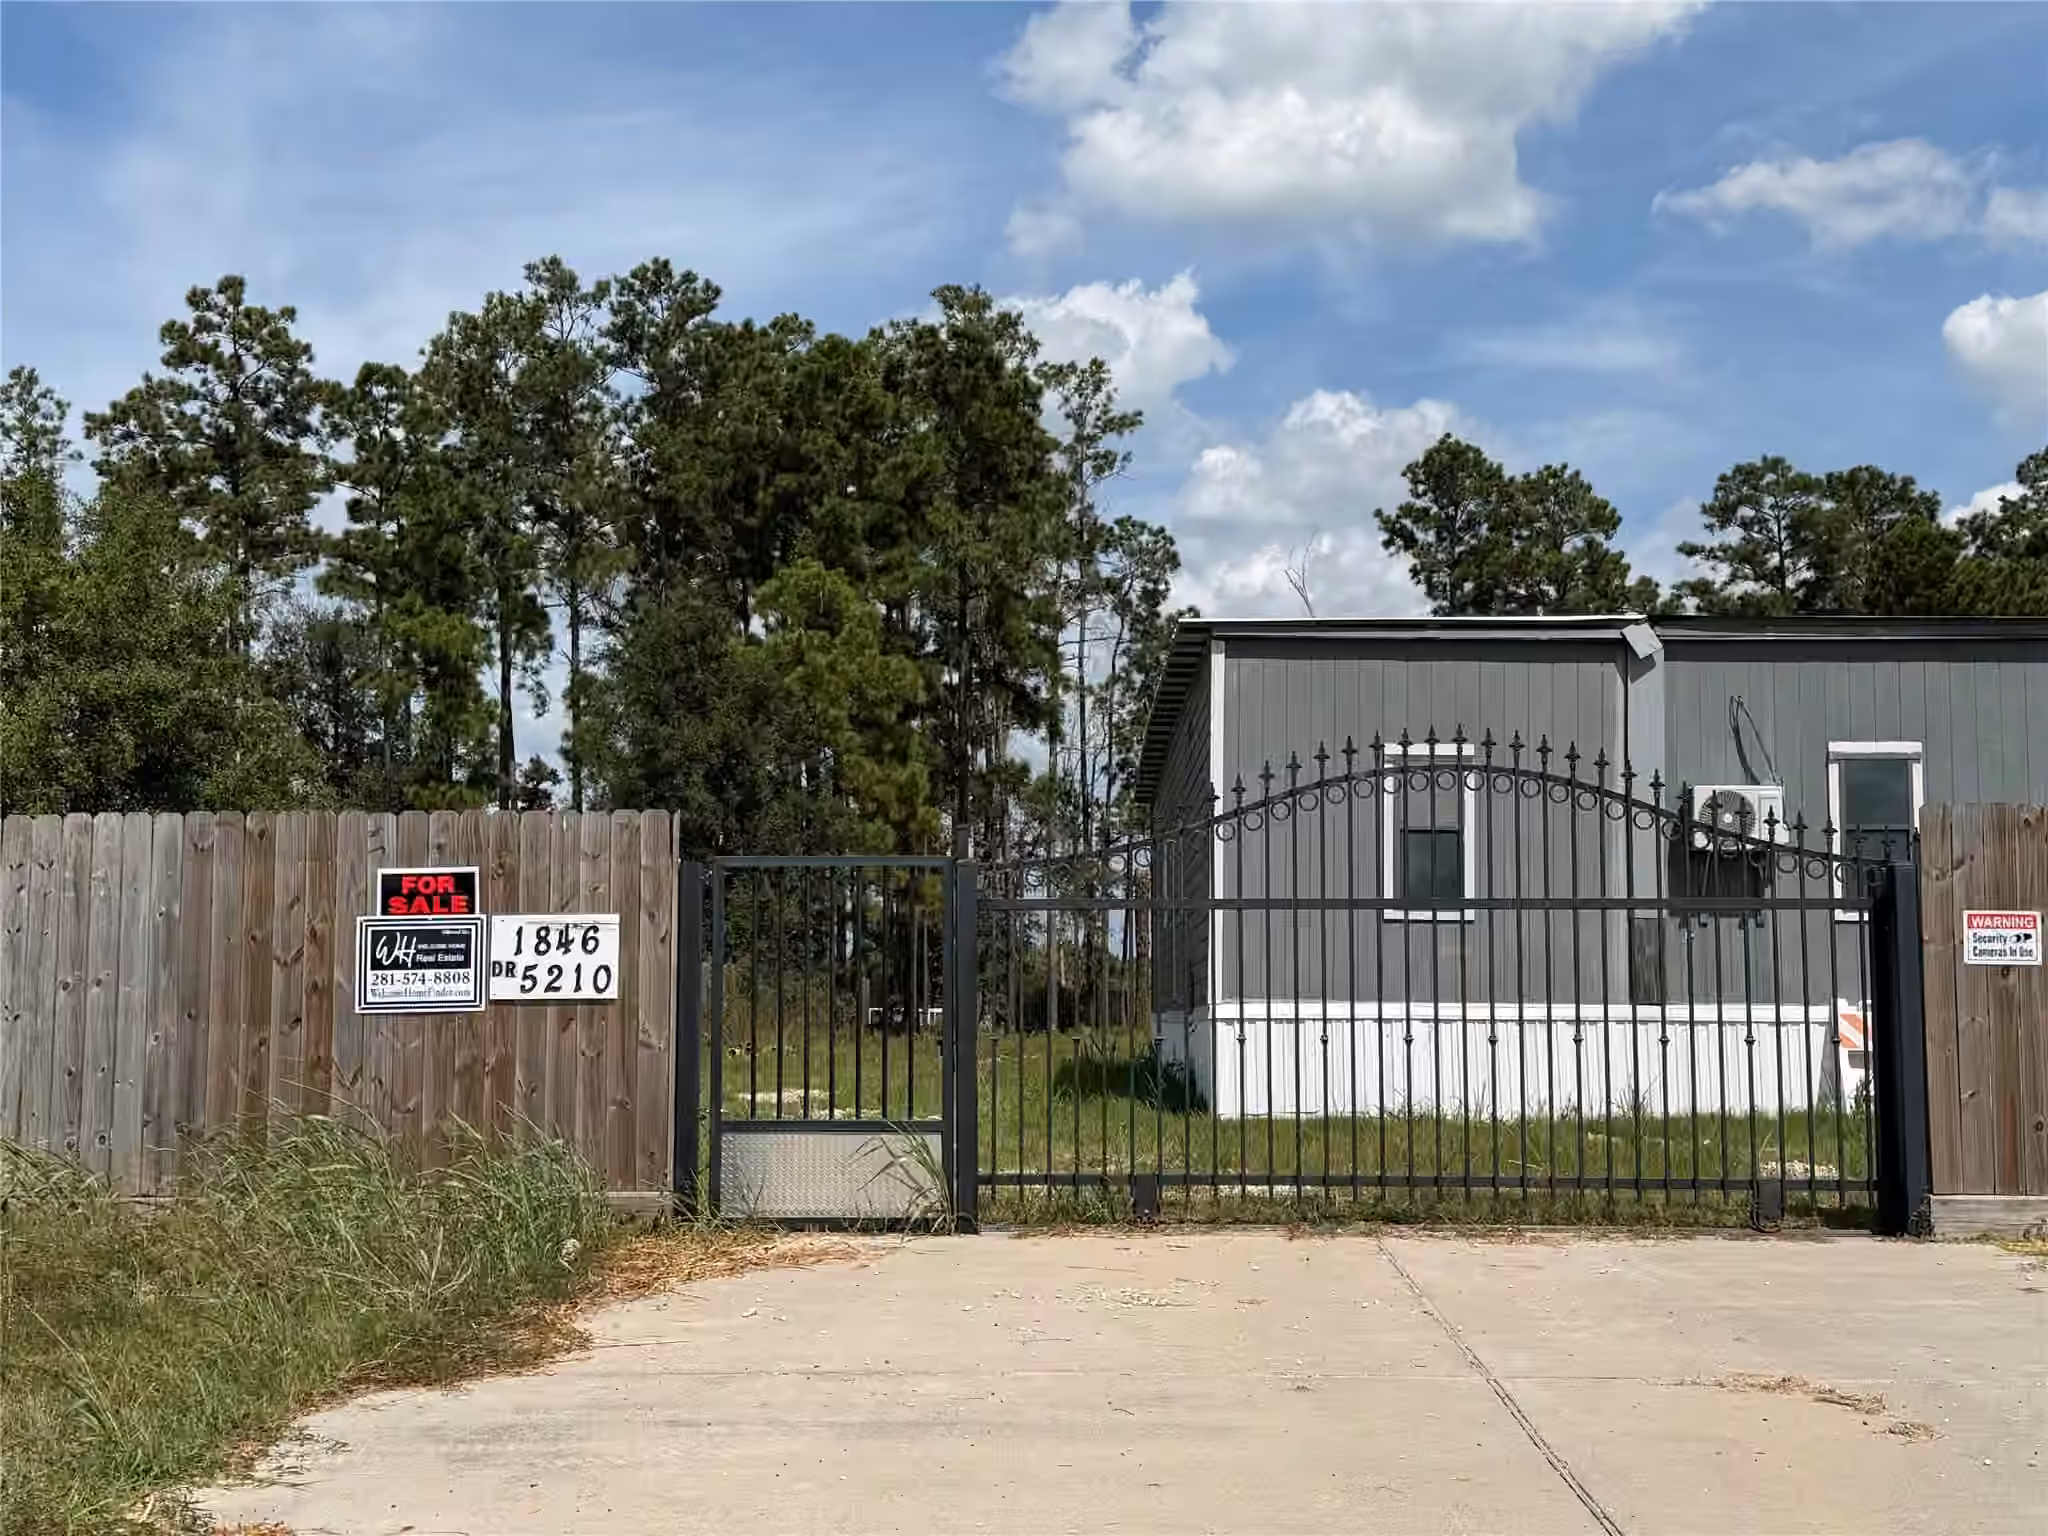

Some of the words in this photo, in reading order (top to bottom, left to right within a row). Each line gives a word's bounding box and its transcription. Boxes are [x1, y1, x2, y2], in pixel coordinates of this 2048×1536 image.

[401, 876, 455, 894] FOR
[388, 896, 469, 914] SALE
[1971, 915, 2034, 928] WARNING
[514, 923, 600, 956] 1846
[1972, 932, 2008, 944] Security
[1972, 946, 2007, 957] Cameras
[371, 971, 471, 986] 281-574-8808
[492, 961, 516, 978] DR
[520, 962, 612, 994] 5210
[370, 987, 471, 998] WelHomeFinder.com
